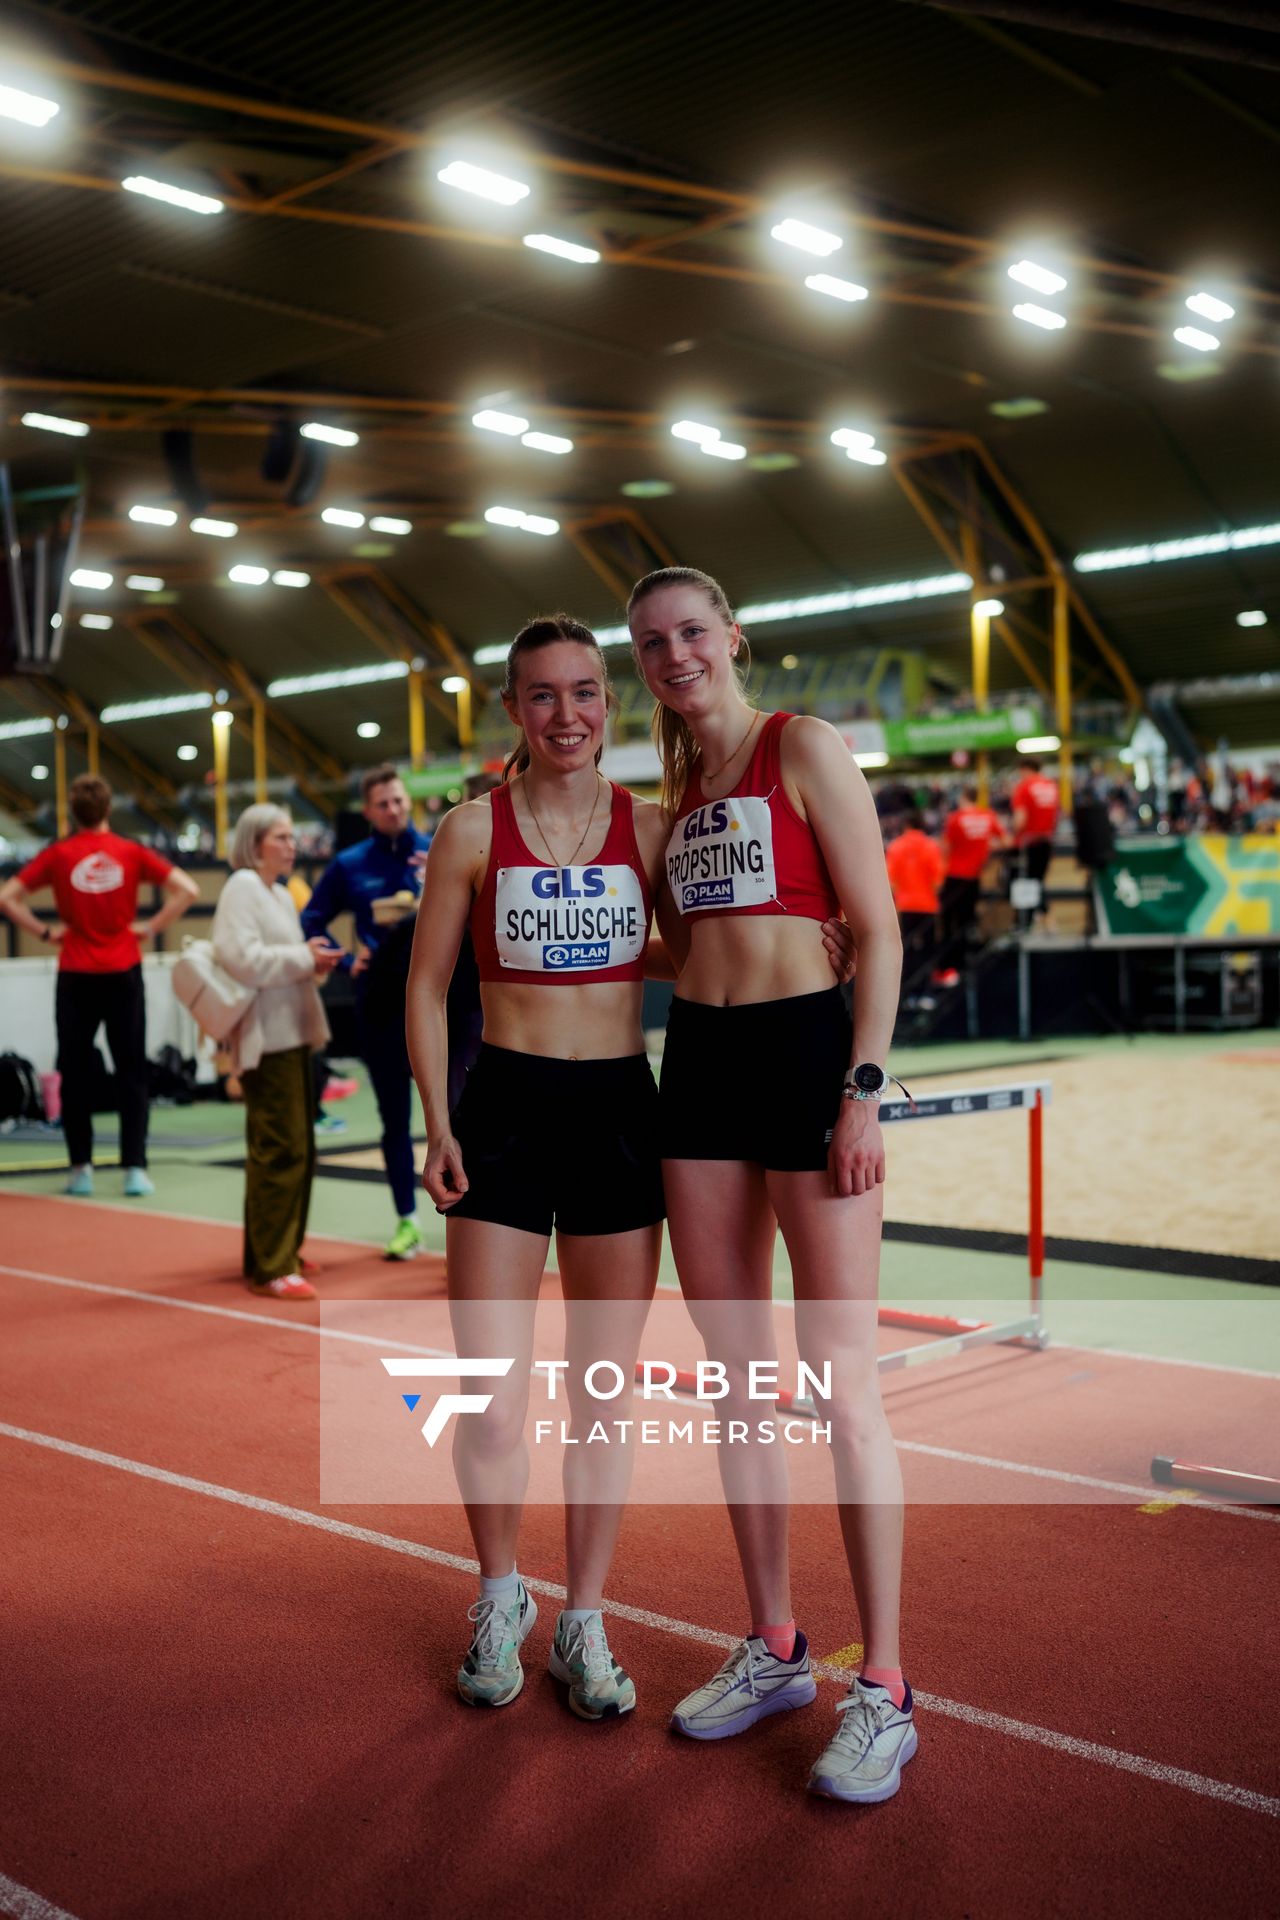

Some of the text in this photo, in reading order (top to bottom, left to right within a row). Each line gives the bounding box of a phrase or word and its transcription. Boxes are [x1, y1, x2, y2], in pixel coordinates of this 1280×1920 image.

[668, 839, 765, 888] PRÖPSTING
[699, 884, 731, 896] PLAN
[506, 900, 637, 941] SCHLÜSCHE
[571, 945, 607, 959] PLAN
